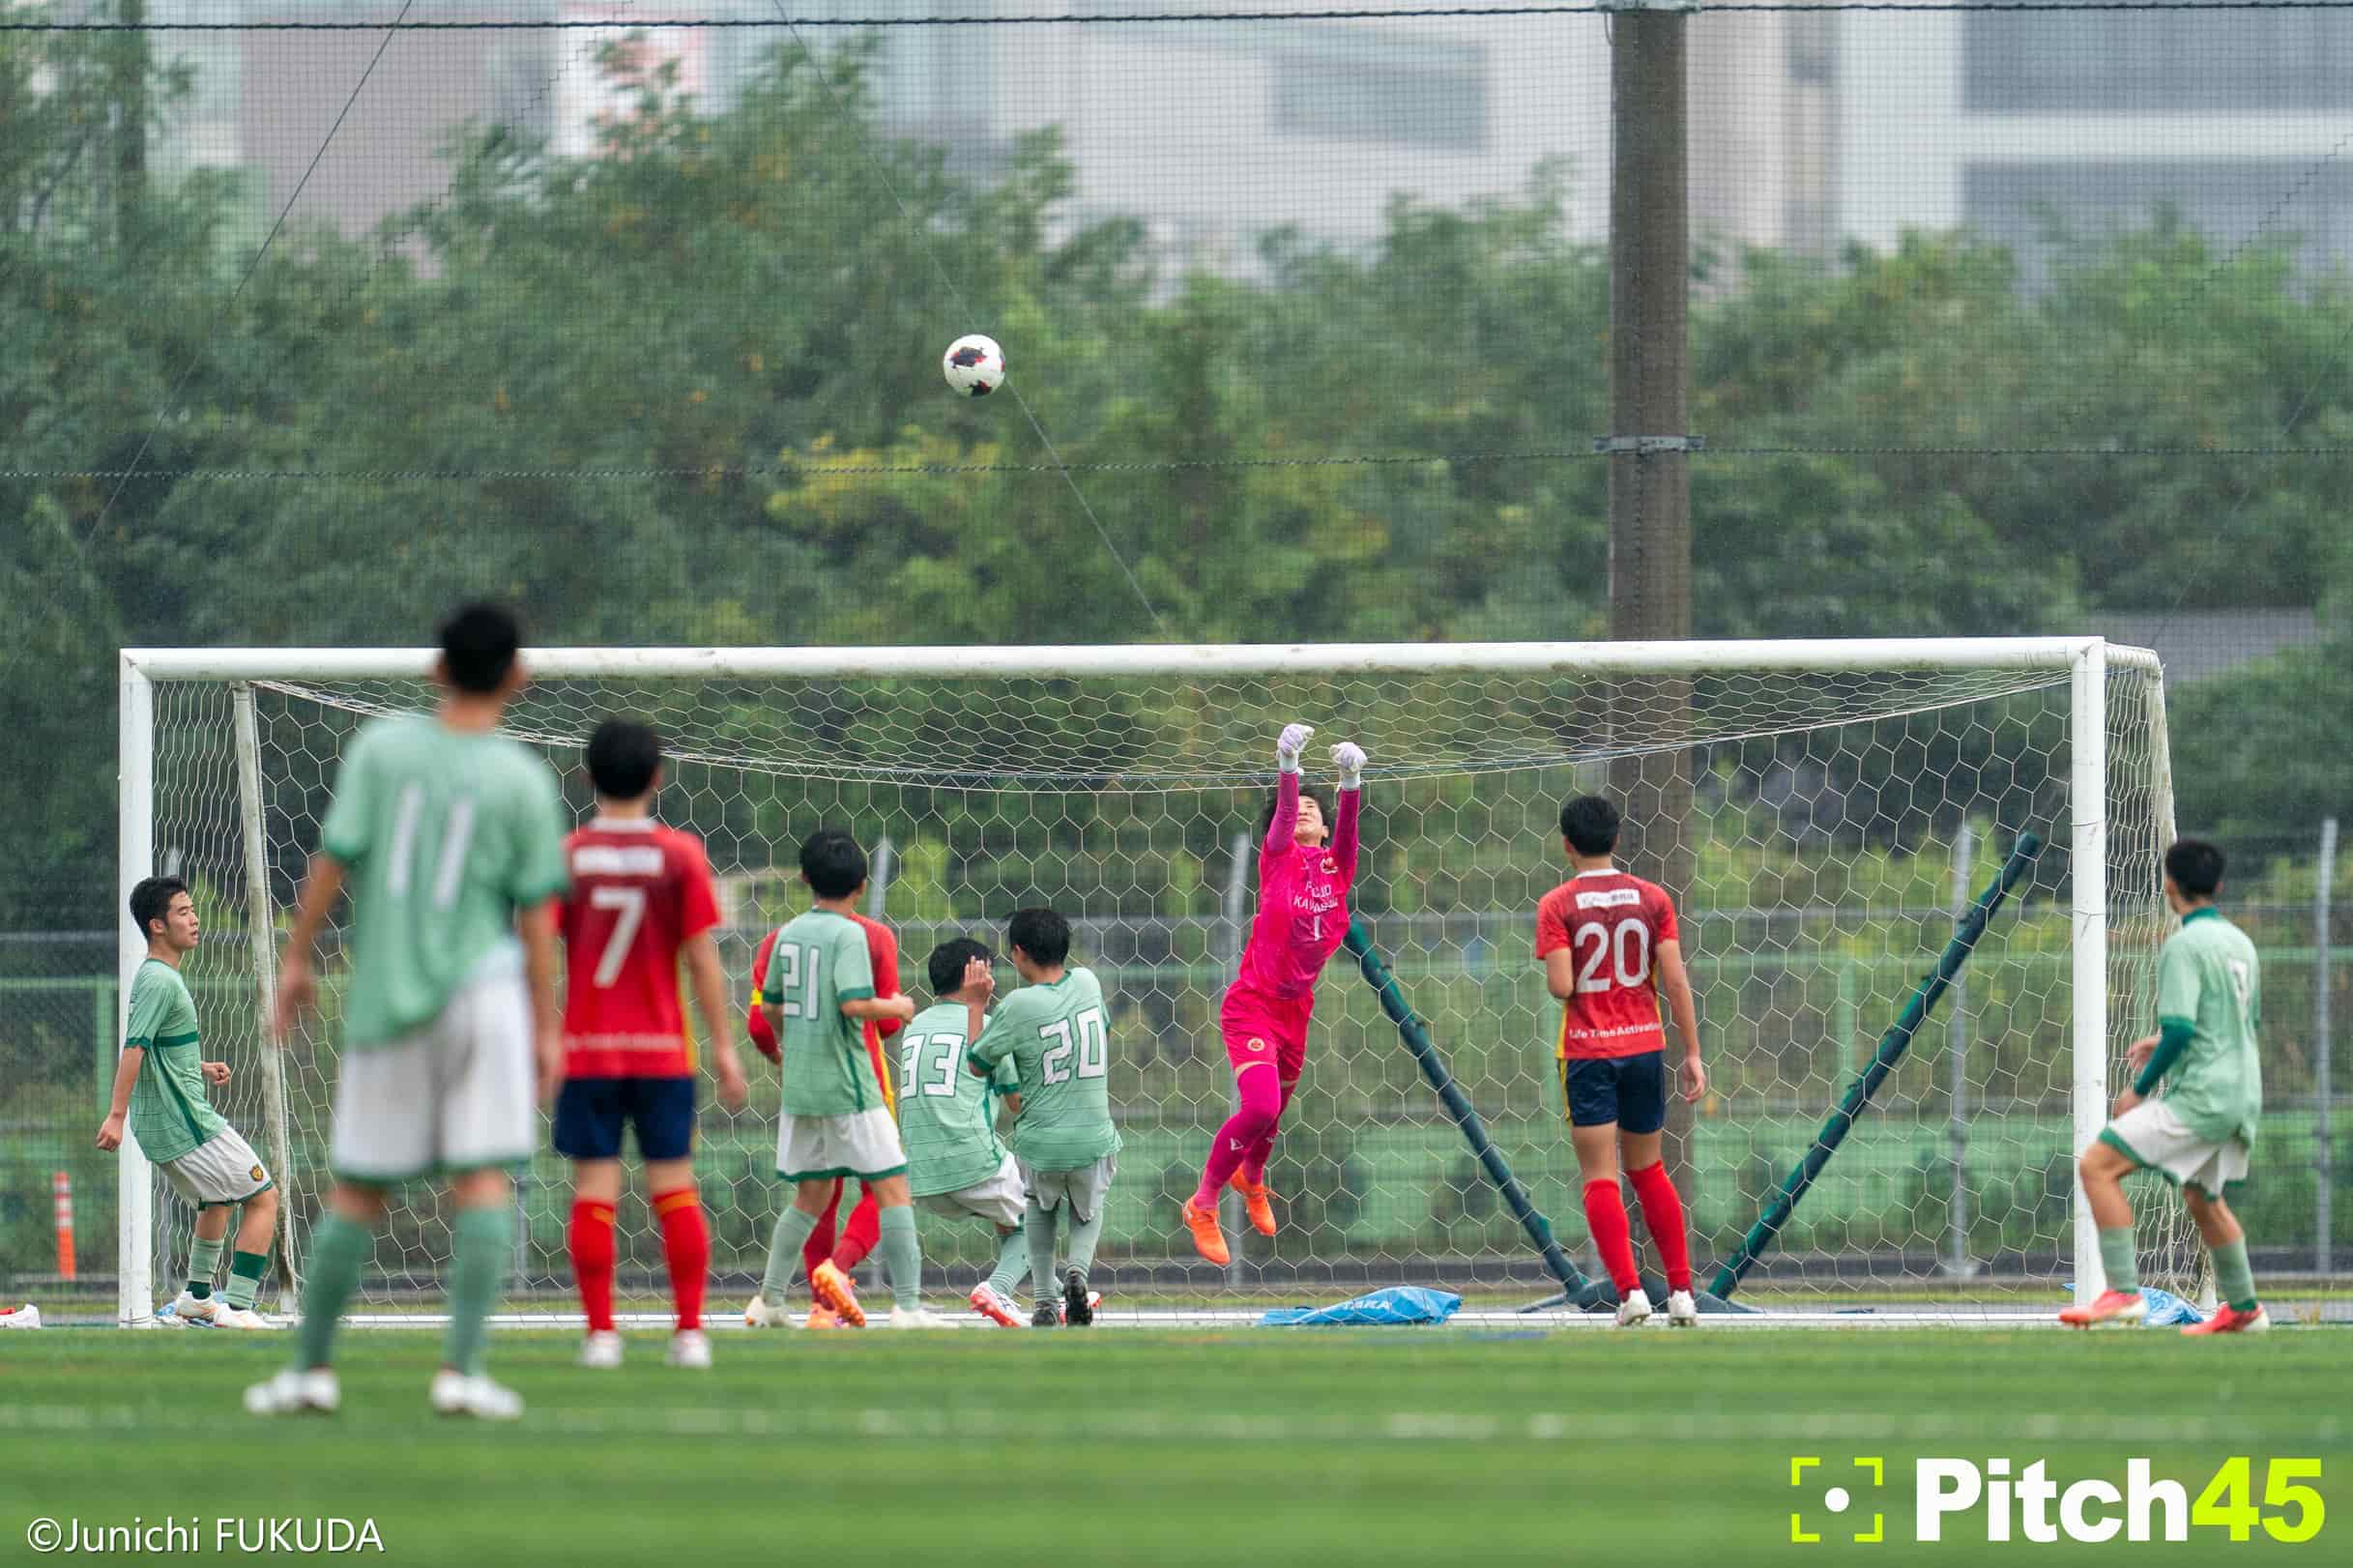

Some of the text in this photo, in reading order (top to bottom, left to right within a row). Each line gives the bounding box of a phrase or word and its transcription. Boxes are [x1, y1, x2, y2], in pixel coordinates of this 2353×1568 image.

[386, 784, 475, 910] 11
[591, 886, 646, 988] 7
[1575, 918, 1650, 994] 20
[778, 942, 820, 1021] 21
[900, 1031, 965, 1098] 33
[1038, 1006, 1106, 1086] 20
[1569, 1029, 1587, 1038] Life
[1589, 1027, 1615, 1038] Time
